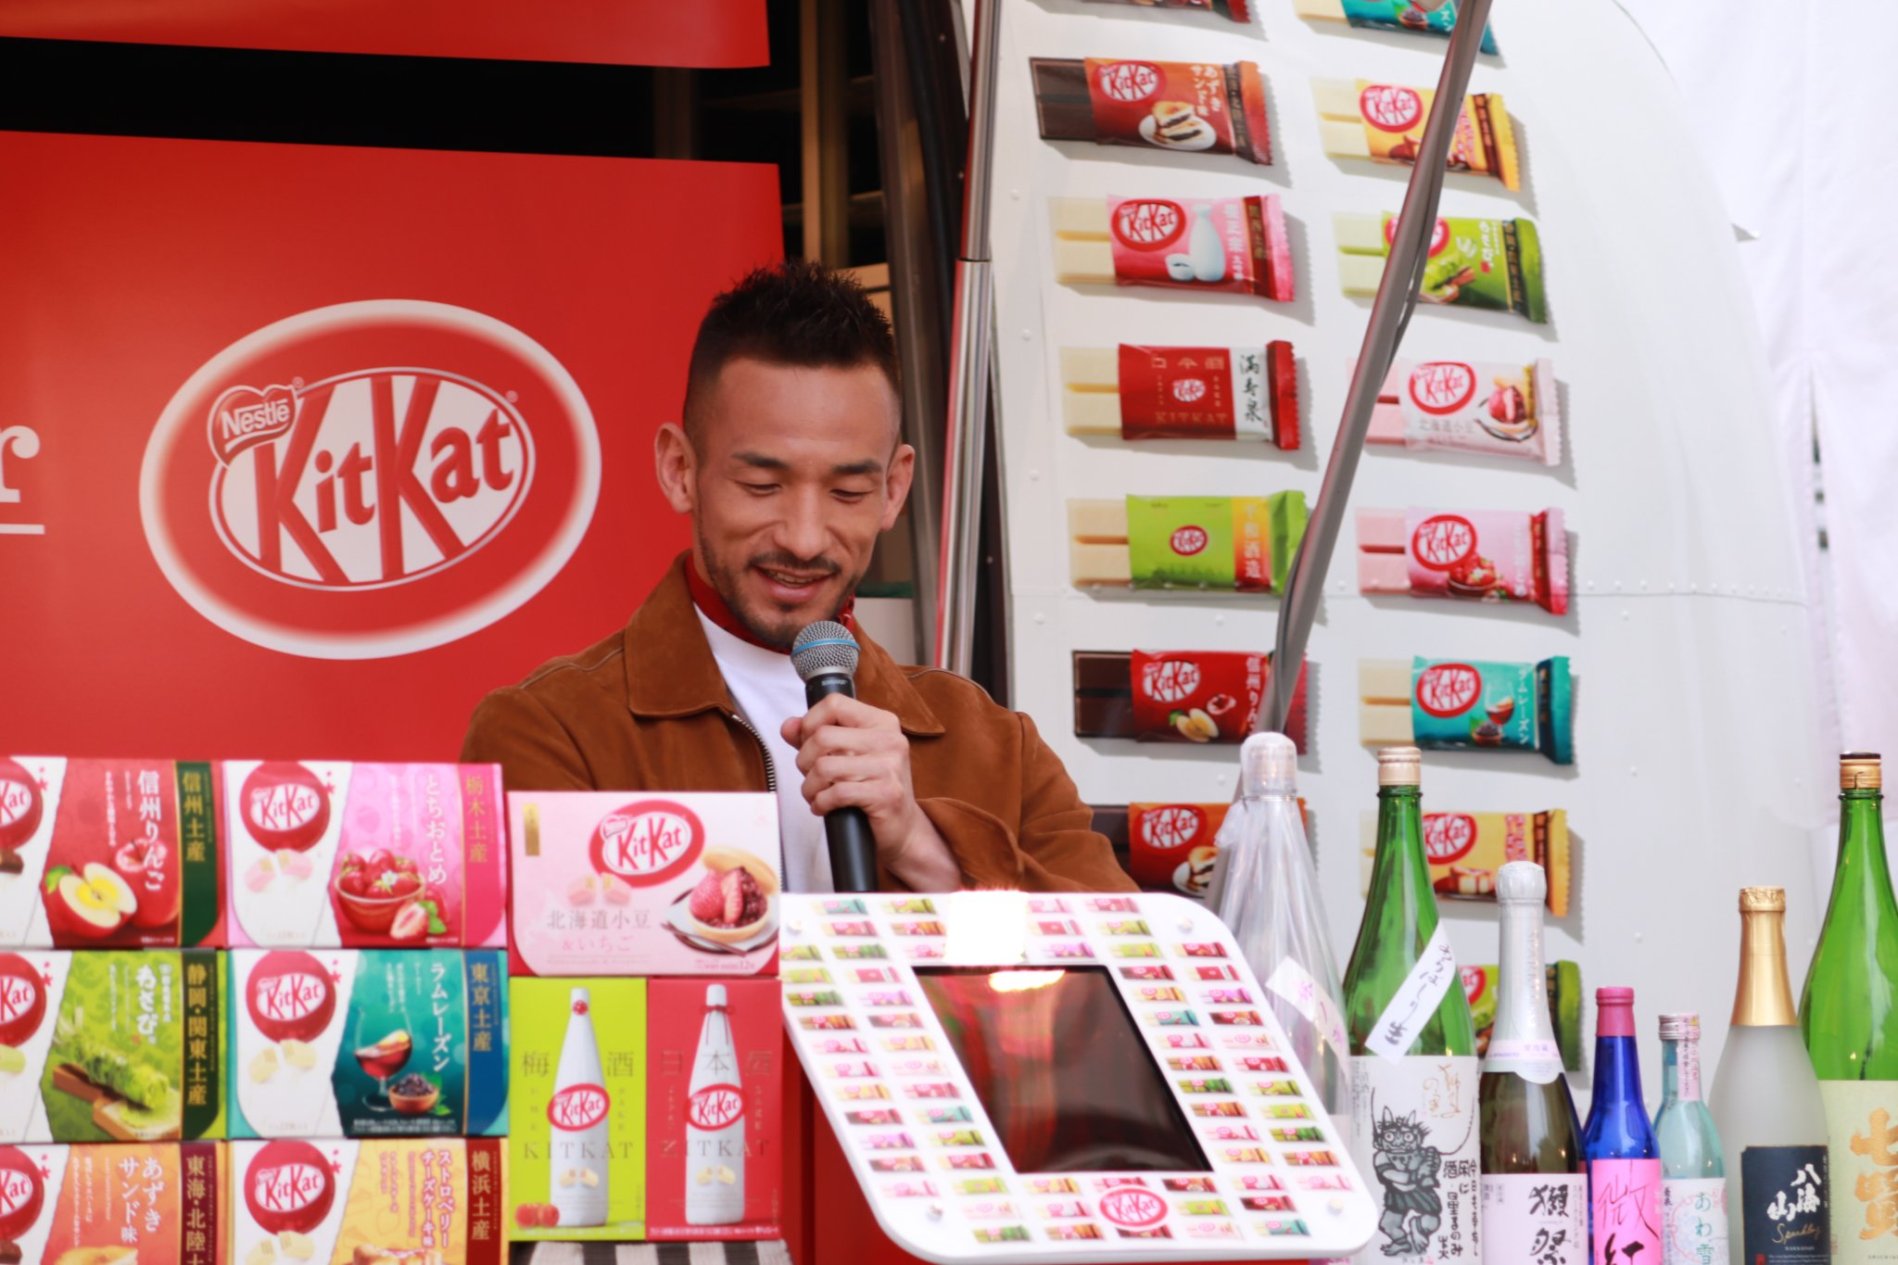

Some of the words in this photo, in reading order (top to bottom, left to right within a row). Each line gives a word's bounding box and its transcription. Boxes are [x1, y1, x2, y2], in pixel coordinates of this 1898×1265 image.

[1109, 64, 1154, 100] KitKat
[1127, 204, 1174, 241] KitKat
[1424, 368, 1463, 403] KitKat
[252, 374, 516, 584] KitKat
[1427, 523, 1467, 561] KitKat
[1151, 661, 1197, 702] KitKat
[1430, 669, 1471, 708] KitKat
[1517, 666, 1530, 744] ラムレーズン
[137, 769, 166, 891] 信州りんご
[182, 771, 206, 862] 信州土産
[260, 785, 315, 830] KitKat
[425, 773, 448, 885] とちおとめ
[465, 776, 488, 863] 栃木土産
[1150, 809, 1197, 847] KitKat
[616, 816, 683, 870] KitKat
[547, 910, 652, 930] 北海道小豆
[266, 975, 321, 1019] KitKat
[429, 962, 452, 1072] ラムレーズン
[470, 963, 493, 1052] 東京土産
[560, 1092, 601, 1125] KitKat
[698, 1091, 738, 1125] KitKat
[523, 1142, 635, 1160] KITKAT
[118, 1157, 140, 1243] サンド味
[142, 1157, 165, 1232] あずき
[264, 1165, 320, 1211] KitKat
[421, 1150, 436, 1248] チーズケーキ味
[438, 1150, 455, 1248] ストロベリー
[471, 1150, 492, 1241] 横浜土産
[1112, 1194, 1156, 1222] KitKat
[1767, 1163, 1822, 1222] 八海山
[1528, 1183, 1573, 1265] 獺祭
